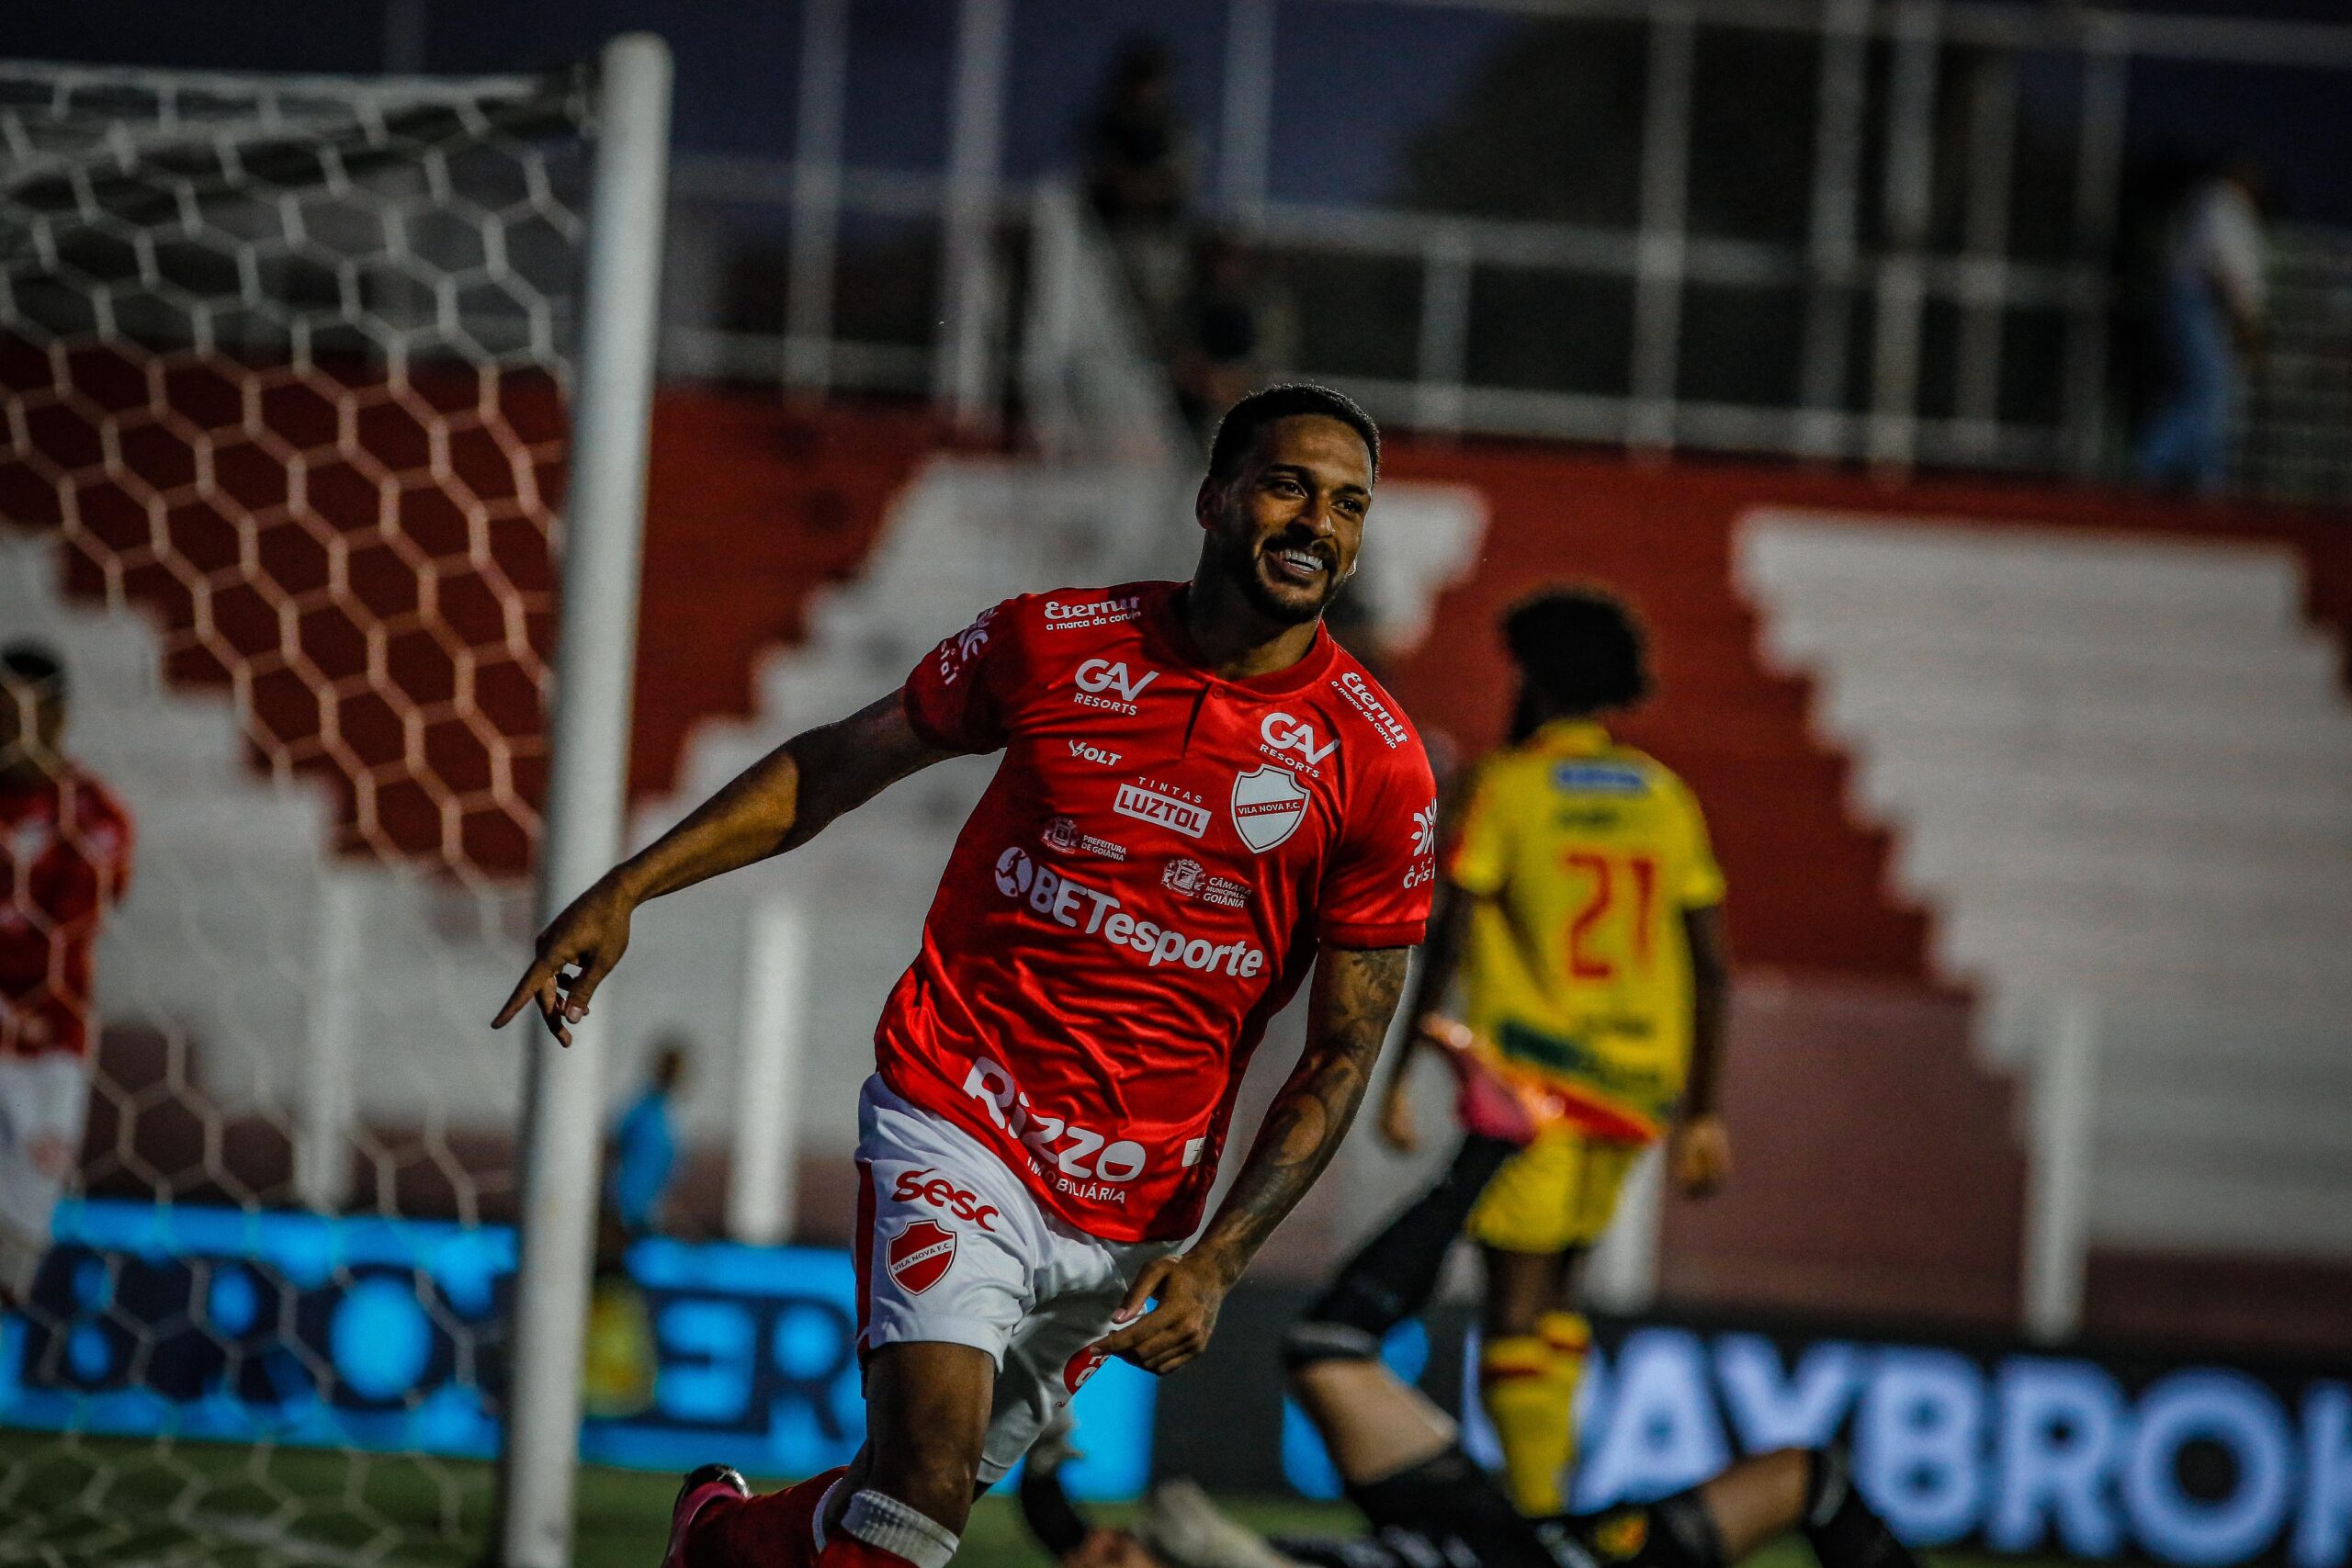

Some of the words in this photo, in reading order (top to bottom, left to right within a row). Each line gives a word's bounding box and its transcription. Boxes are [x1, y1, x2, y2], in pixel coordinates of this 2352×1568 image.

[1044, 597, 1139, 619] Eternit
[1056, 619, 1090, 630] marca
[1092, 616, 1107, 626] da
[1109, 611, 1141, 624] coruja
[1074, 659, 1160, 702] GAV
[1073, 692, 1138, 716] RESORTS
[1341, 671, 1409, 744] Eternit
[1338, 687, 1363, 711] marca
[1363, 710, 1375, 722] da
[1374, 722, 1397, 750] coruja
[1069, 739, 1122, 766] VOLT
[1261, 712, 1341, 766] GAV
[1260, 743, 1320, 778] RESORTS
[1138, 776, 1203, 804] TINTAS
[1118, 790, 1201, 833] LUZTOL
[1238, 805, 1257, 815] VILA
[1259, 803, 1284, 812] NOVA
[1285, 800, 1301, 810] F.C.
[1081, 842, 1091, 852] DE
[1091, 845, 1125, 862] GOIÂNIA
[1082, 834, 1126, 854] PREFEITURA
[1203, 893, 1245, 908] GOIÂNIA
[1205, 886, 1239, 898] MUNICIPAL
[1209, 877, 1252, 896] CÂMARA
[1029, 865, 1264, 977] BETesporte
[1564, 852, 1656, 980] 21
[963, 1056, 1147, 1182] Rizzo
[1027, 1156, 1125, 1204] IMOBILIÁRIA
[890, 1168, 1000, 1233] sesc
[893, 1259, 910, 1271] VILA
[911, 1247, 936, 1263] NOVA
[937, 1243, 952, 1251] F.C.
